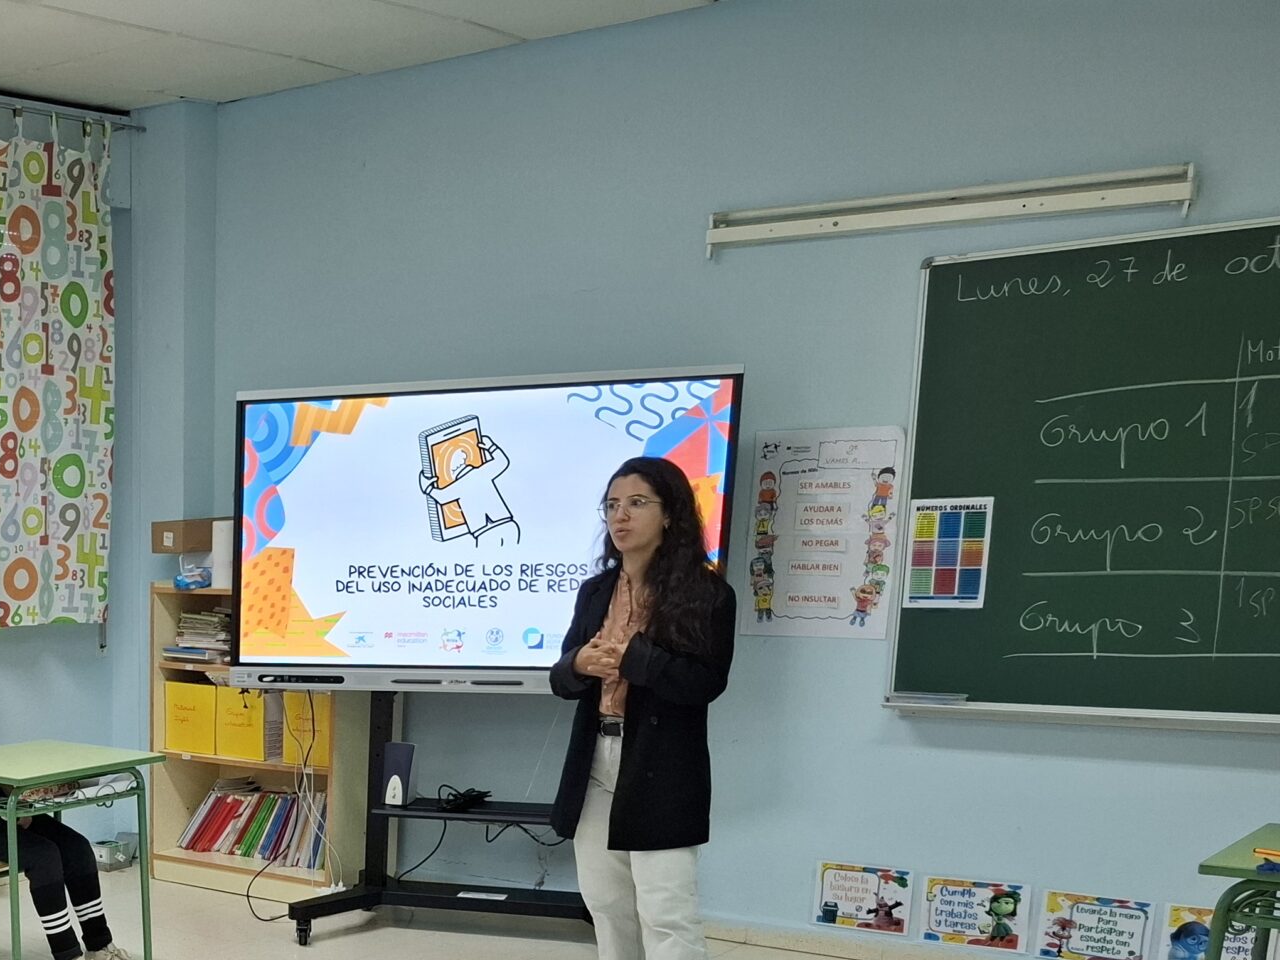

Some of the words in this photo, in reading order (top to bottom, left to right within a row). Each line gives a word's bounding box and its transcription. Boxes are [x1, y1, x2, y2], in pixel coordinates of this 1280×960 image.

[957, 274, 1070, 301] Lunes,
[1086, 257, 1139, 288] 27
[1153, 249, 1188, 285] de
[1040, 414, 1170, 469] Grupo
[1185, 402, 1206, 436] 1
[815, 481, 851, 490] AMABLES
[803, 506, 833, 514] AYUDAR
[916, 504, 947, 512] NÚMEROS
[800, 518, 814, 526] LOS
[815, 516, 843, 526] DEMÁS
[801, 539, 815, 547] NO
[816, 538, 839, 548] PEGAR
[1031, 513, 1163, 572] Grupo
[1182, 506, 1217, 545] 2
[348, 563, 447, 580] PREVENCIÓN
[454, 564, 474, 577] DE
[482, 564, 513, 577] LOS
[520, 563, 588, 577] RIESGOS
[790, 563, 820, 571] HABLAR
[821, 563, 839, 571] BIEN
[336, 581, 365, 594] DEL
[371, 581, 401, 593] USO
[408, 579, 510, 595] INADECUADO
[518, 579, 539, 593] DE
[547, 579, 585, 593] RED
[423, 595, 498, 609] SOCIALES
[788, 595, 800, 603] NO
[802, 595, 837, 604] INSULTAR
[1020, 601, 1142, 659] Grupo
[1175, 608, 1201, 643] 3
[940, 898, 955, 907] con
[957, 899, 974, 909] mis
[935, 907, 978, 920] trabajos
[1076, 905, 1108, 916] Levanto
[1109, 908, 1117, 918] la
[1119, 912, 1141, 920] mano
[935, 919, 942, 927] y
[944, 919, 977, 930] tareas
[1128, 931, 1134, 939] y
[1224, 936, 1248, 945] odos
[1080, 935, 1114, 945] escucho
[1115, 939, 1130, 948] con
